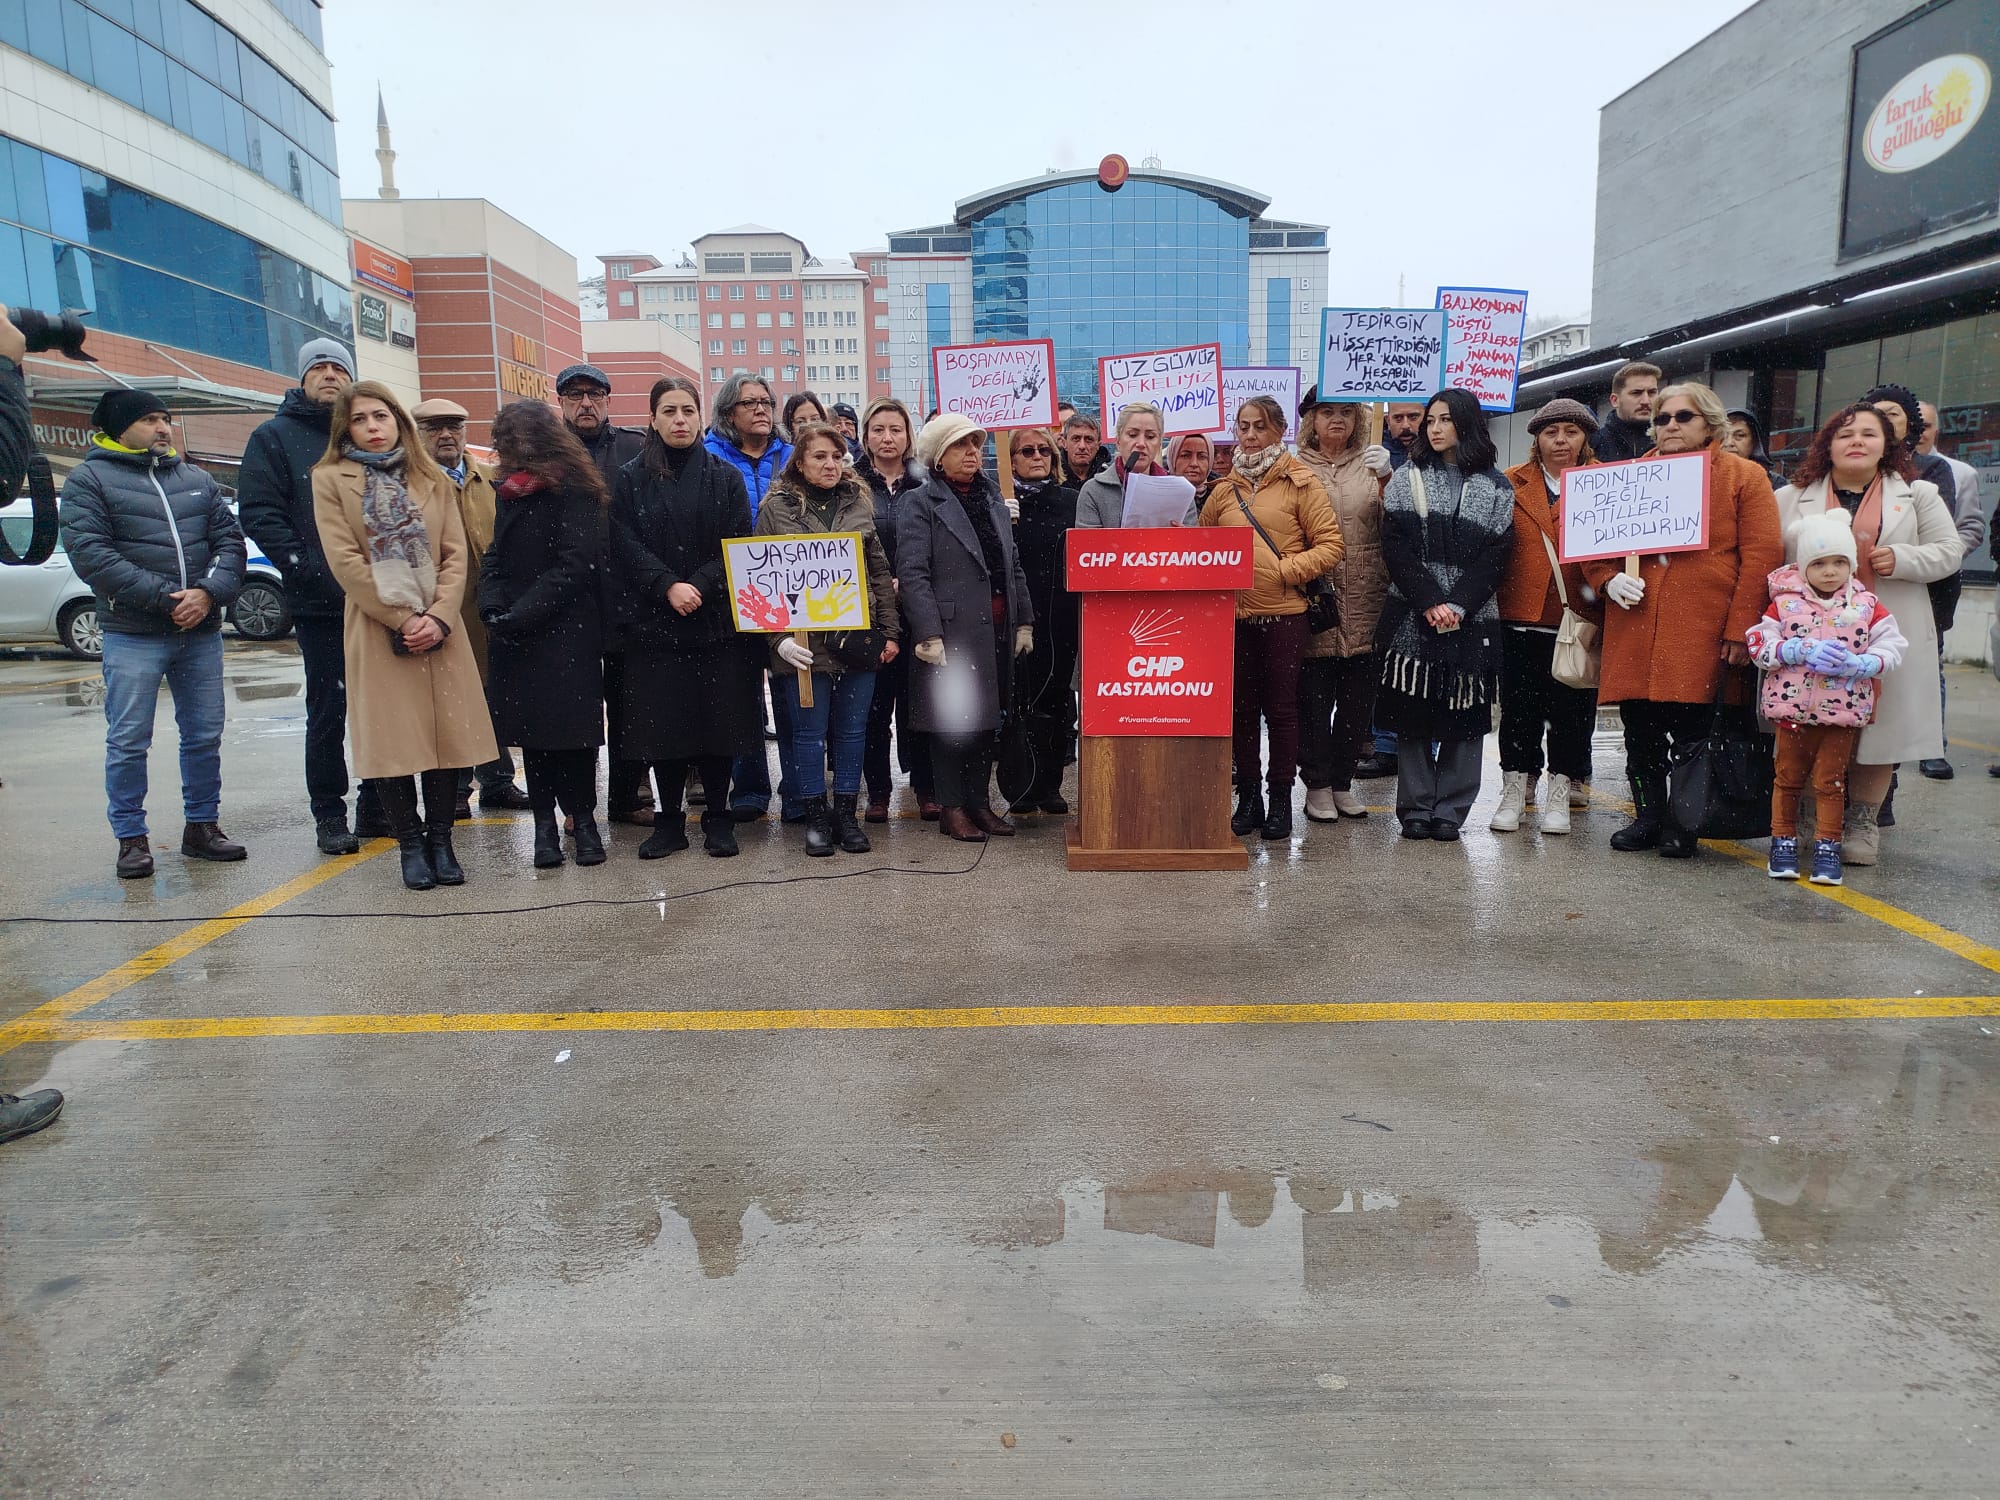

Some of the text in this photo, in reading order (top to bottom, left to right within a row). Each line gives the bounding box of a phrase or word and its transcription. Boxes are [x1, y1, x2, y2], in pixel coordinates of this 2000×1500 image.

[1884, 83, 1934, 126] faruk
[1882, 101, 1963, 160] güllüoğlu
[1442, 294, 1523, 315] BALKONDAN
[513, 334, 537, 367] MM
[1454, 332, 1519, 347] DERLERSE
[945, 350, 1040, 372] BOŞANMAYI
[1346, 352, 1430, 371] HER KADININ
[1110, 370, 1216, 397] ÖFKELİYİZ
[1362, 366, 1416, 380] HESABINI
[1453, 377, 1484, 389] ÇOK
[1335, 379, 1427, 394] SORACAĞIZ
[1574, 463, 1671, 493] KADINLARI
[1594, 485, 1652, 507] DEĞİL
[1572, 496, 1669, 527] KATİLLERİ
[746, 538, 850, 571] YAŞAMAK
[1078, 550, 1242, 568] CHP KASTAMONU
[747, 568, 856, 598] İSTİYORUZ
[1127, 655, 1185, 678] CHP
[1096, 681, 1215, 697] KASTAMONU
